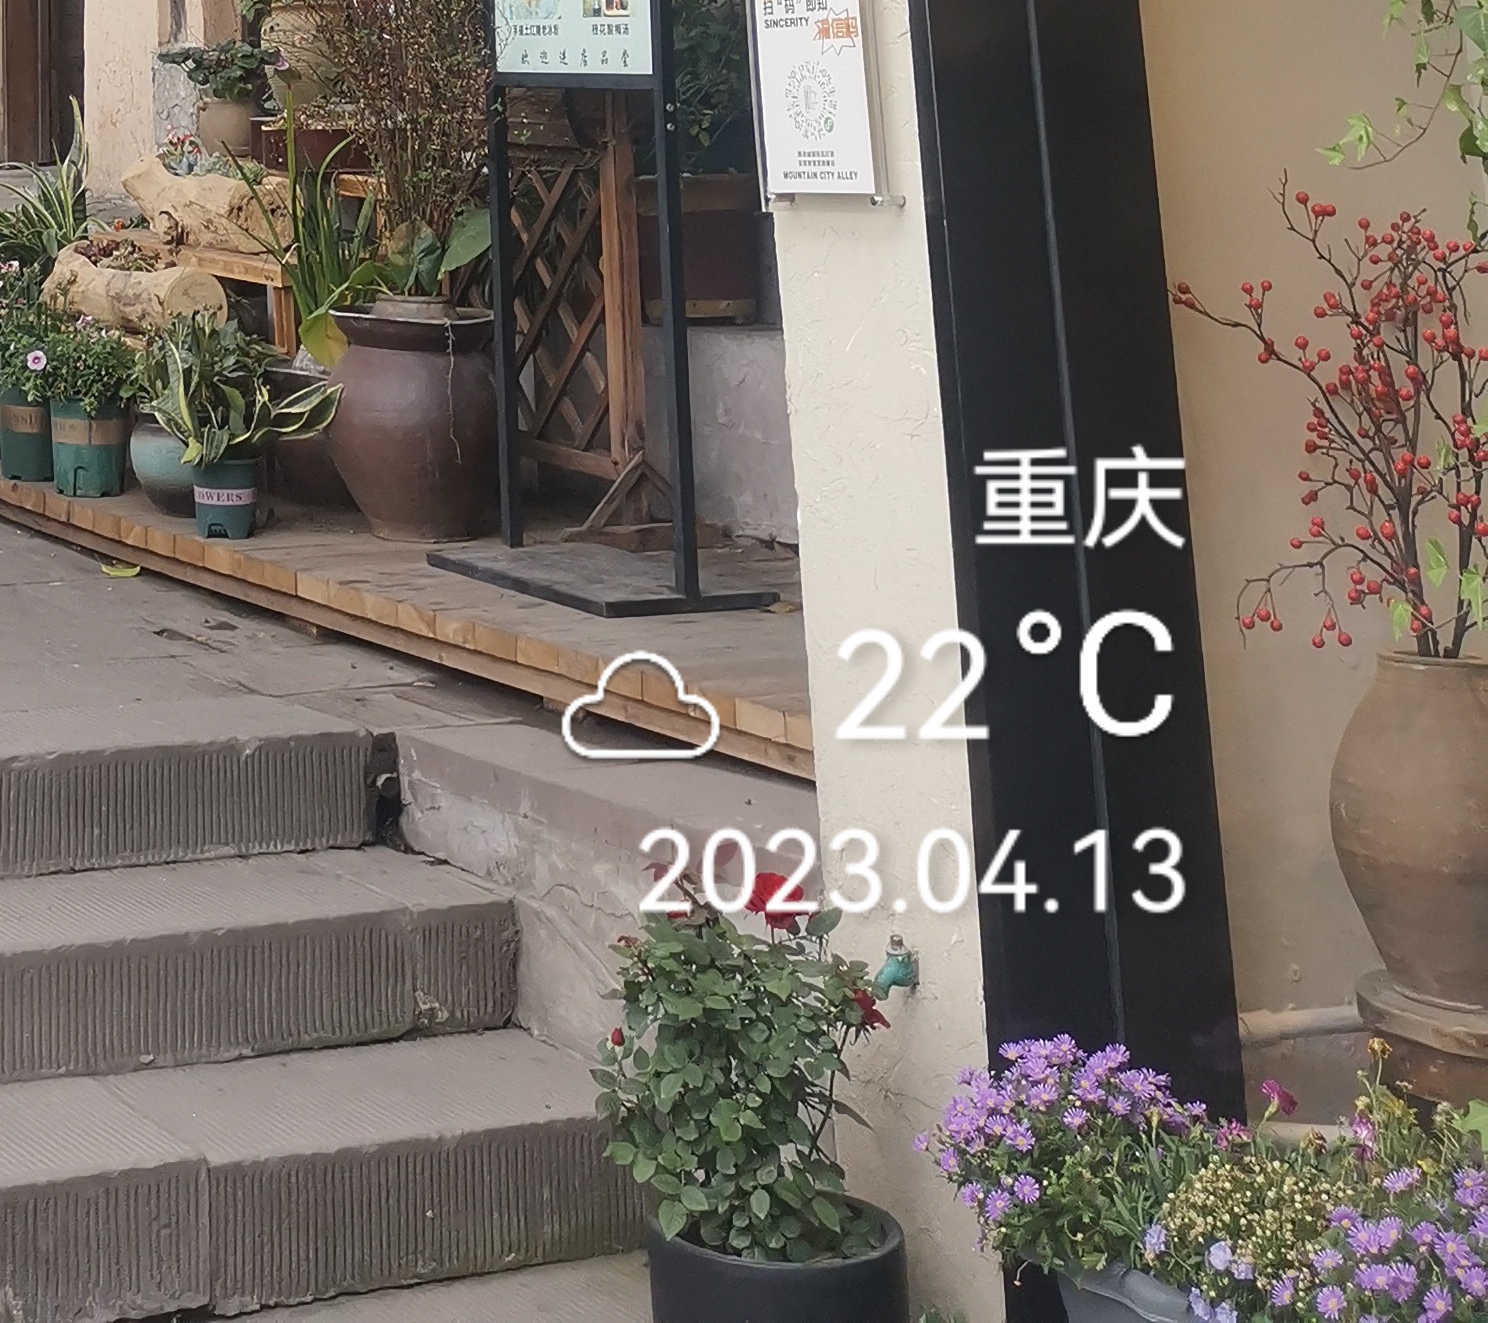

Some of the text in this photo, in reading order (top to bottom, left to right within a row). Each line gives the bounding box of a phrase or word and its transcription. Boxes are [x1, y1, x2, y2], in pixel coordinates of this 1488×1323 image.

[764, 16, 810, 28] SINCERITY
[783, 171, 858, 180] MOUNTAIN CITY ALLEY
[198, 491, 243, 502] OWERS
